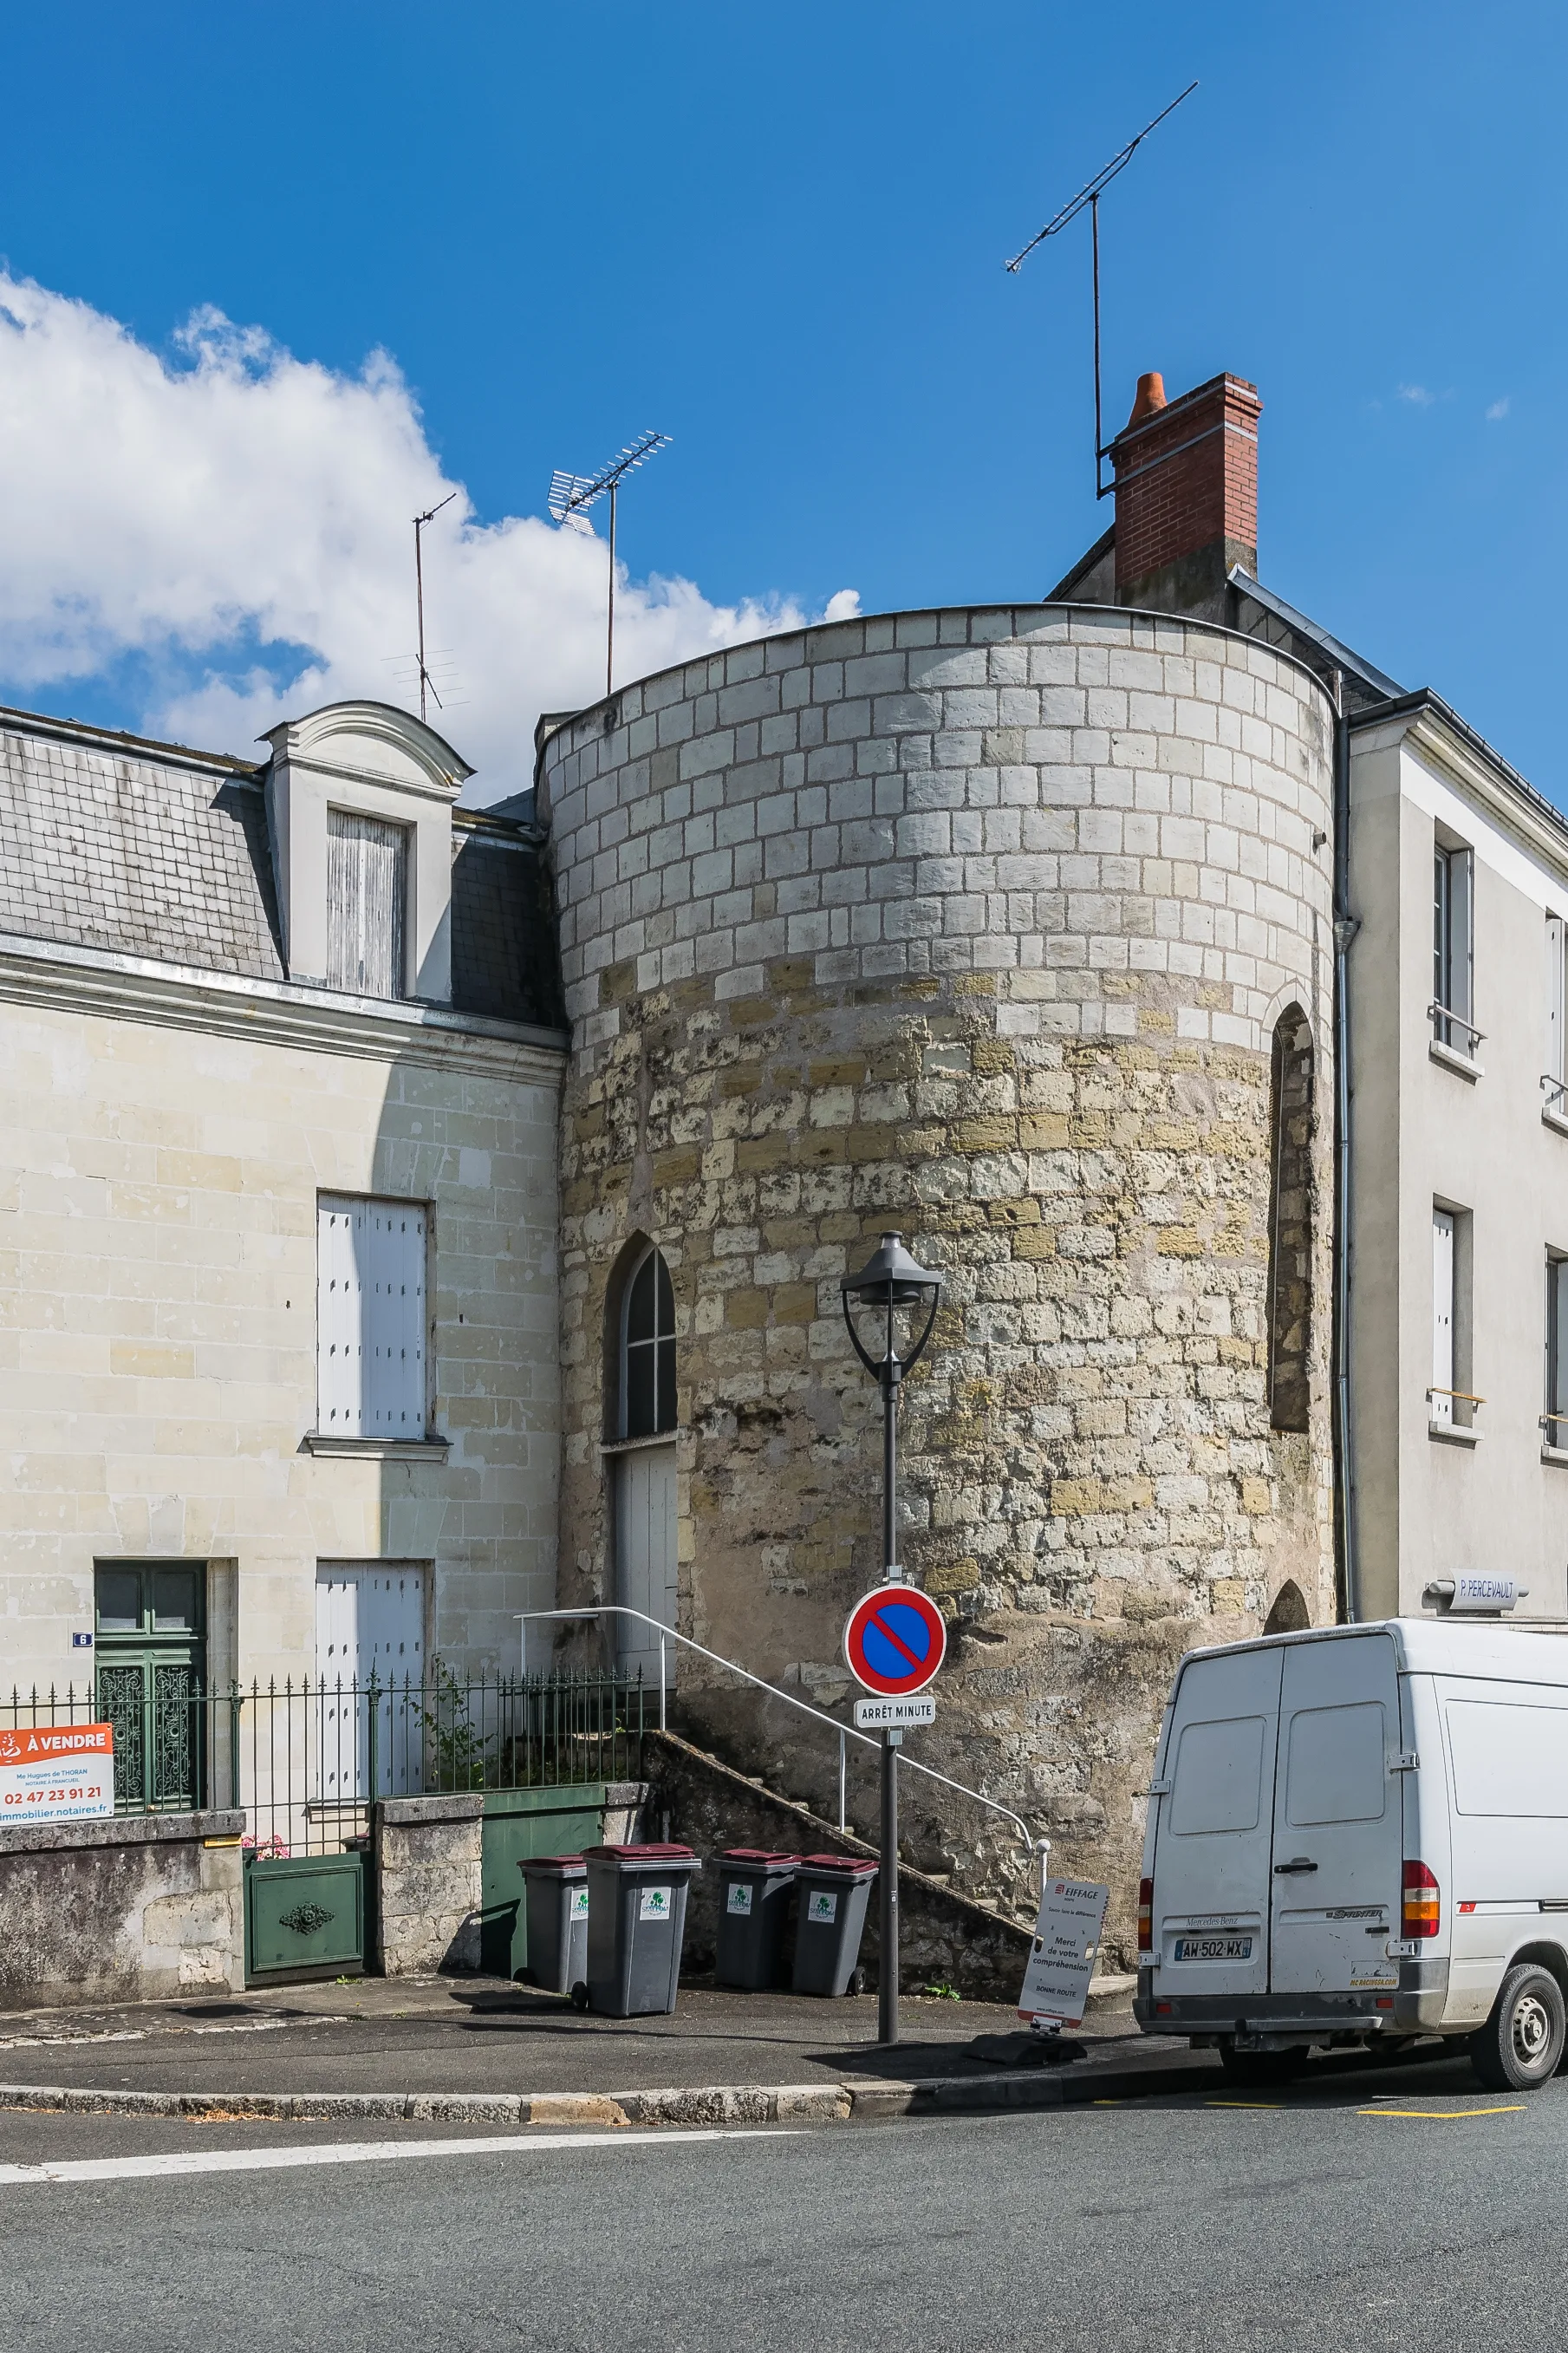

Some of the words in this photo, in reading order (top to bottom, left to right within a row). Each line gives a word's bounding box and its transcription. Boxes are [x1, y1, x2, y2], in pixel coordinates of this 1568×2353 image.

[1461, 1579, 1467, 1596] P.
[1468, 1580, 1513, 1599] PERCEVAULT
[80, 1634, 87, 1645] 6
[862, 1704, 893, 1720] ARRÊT
[895, 1704, 932, 1718] MINUTE
[27, 1734, 39, 1752] À
[41, 1732, 106, 1750] VENDRE
[27, 1771, 51, 1780] Hugues
[4, 1793, 23, 1805] 02
[27, 1791, 44, 1802] 47
[49, 1789, 65, 1802] 23
[68, 1788, 83, 1799] 91
[88, 1786, 101, 1797] 21
[0, 1803, 107, 1822] immobilier.notaires.fr
[1065, 1887, 1099, 1900] EIFFAGE
[1332, 1909, 1383, 1919] SPRINTER
[1186, 1917, 1239, 1927] Mercedes-Benz
[1055, 1936, 1077, 1947] Merci
[1047, 1946, 1057, 1955] de
[1059, 1950, 1079, 1959] votre
[1032, 1957, 1089, 1972] compréhension
[1036, 1985, 1056, 1994] BONNE
[1057, 1988, 1077, 1998] ROUTE
